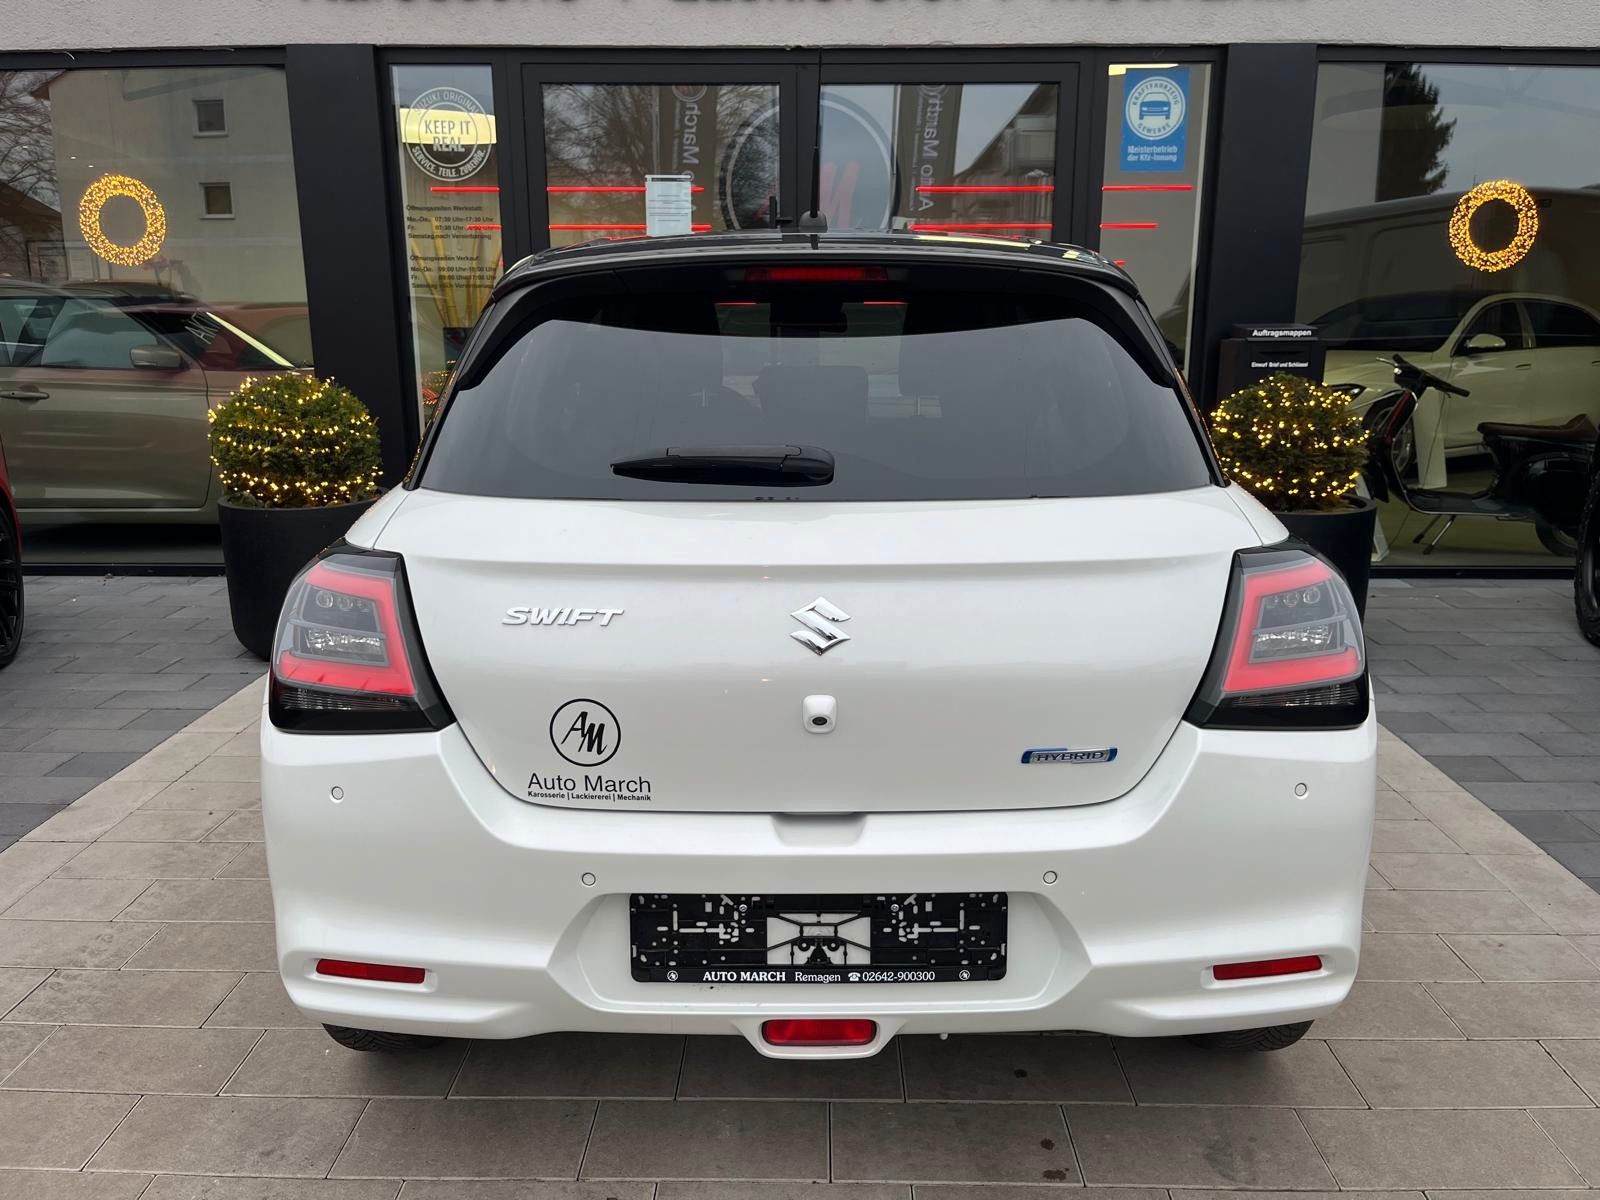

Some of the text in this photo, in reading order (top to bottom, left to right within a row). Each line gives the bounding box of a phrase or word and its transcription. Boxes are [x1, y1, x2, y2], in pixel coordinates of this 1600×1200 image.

[1132, 82, 1181, 106] KRAFTFAHRZEUG
[425, 119, 471, 136] KEEP IT
[433, 136, 466, 152] REAL
[1128, 145, 1178, 153] Meisterbetrieb
[411, 145, 437, 174] SERVICE.
[1252, 329, 1312, 337] Auftragsmappen
[501, 606, 625, 627] SWIFT
[1037, 751, 1105, 762] HYBRID
[528, 772, 652, 793] Auto March
[527, 790, 652, 802] Karosserie Lackiererei Mechanik
[702, 971, 936, 983] AUTO MARCH Remagen 02642-900300
